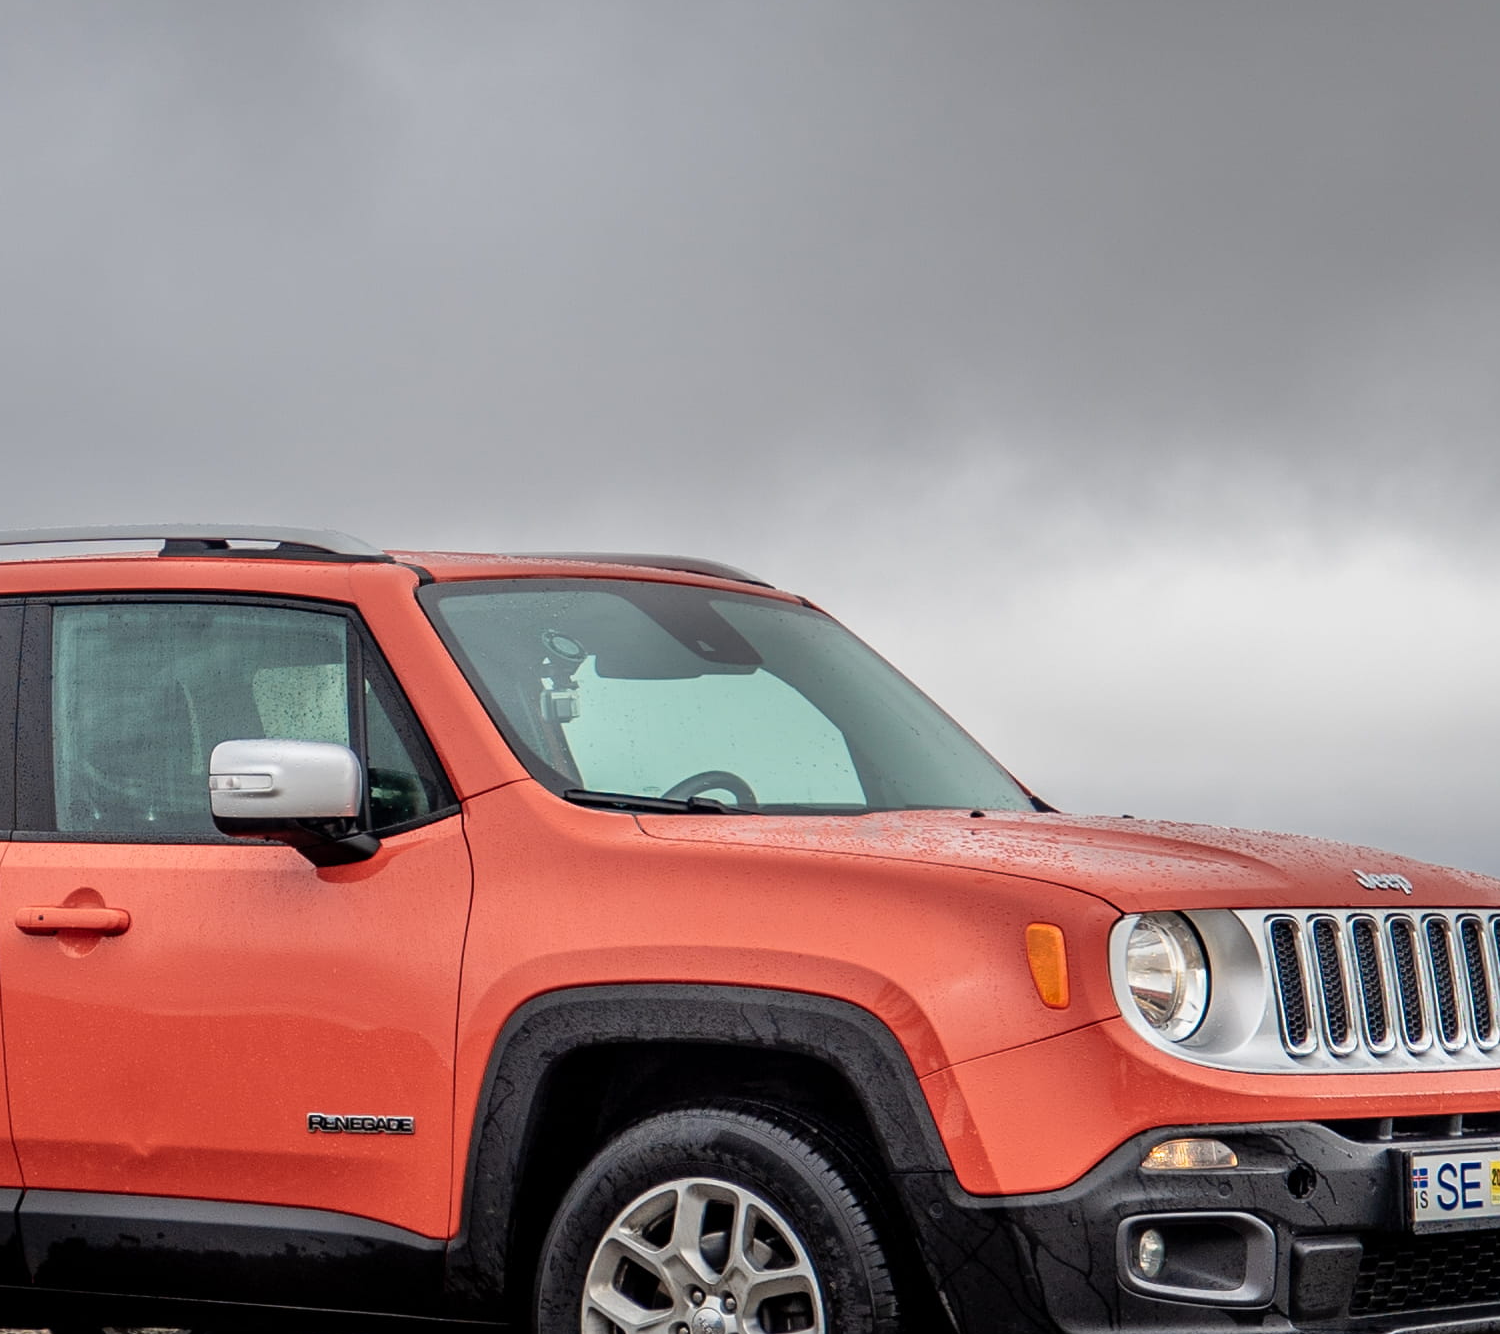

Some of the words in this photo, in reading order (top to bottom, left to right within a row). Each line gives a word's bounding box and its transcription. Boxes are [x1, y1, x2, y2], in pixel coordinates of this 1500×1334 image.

[1352, 869, 1413, 896] Jeep
[307, 1113, 414, 1134] RENEGADE
[1437, 1162, 1483, 1211] SE
[1416, 1190, 1428, 1210] IS
